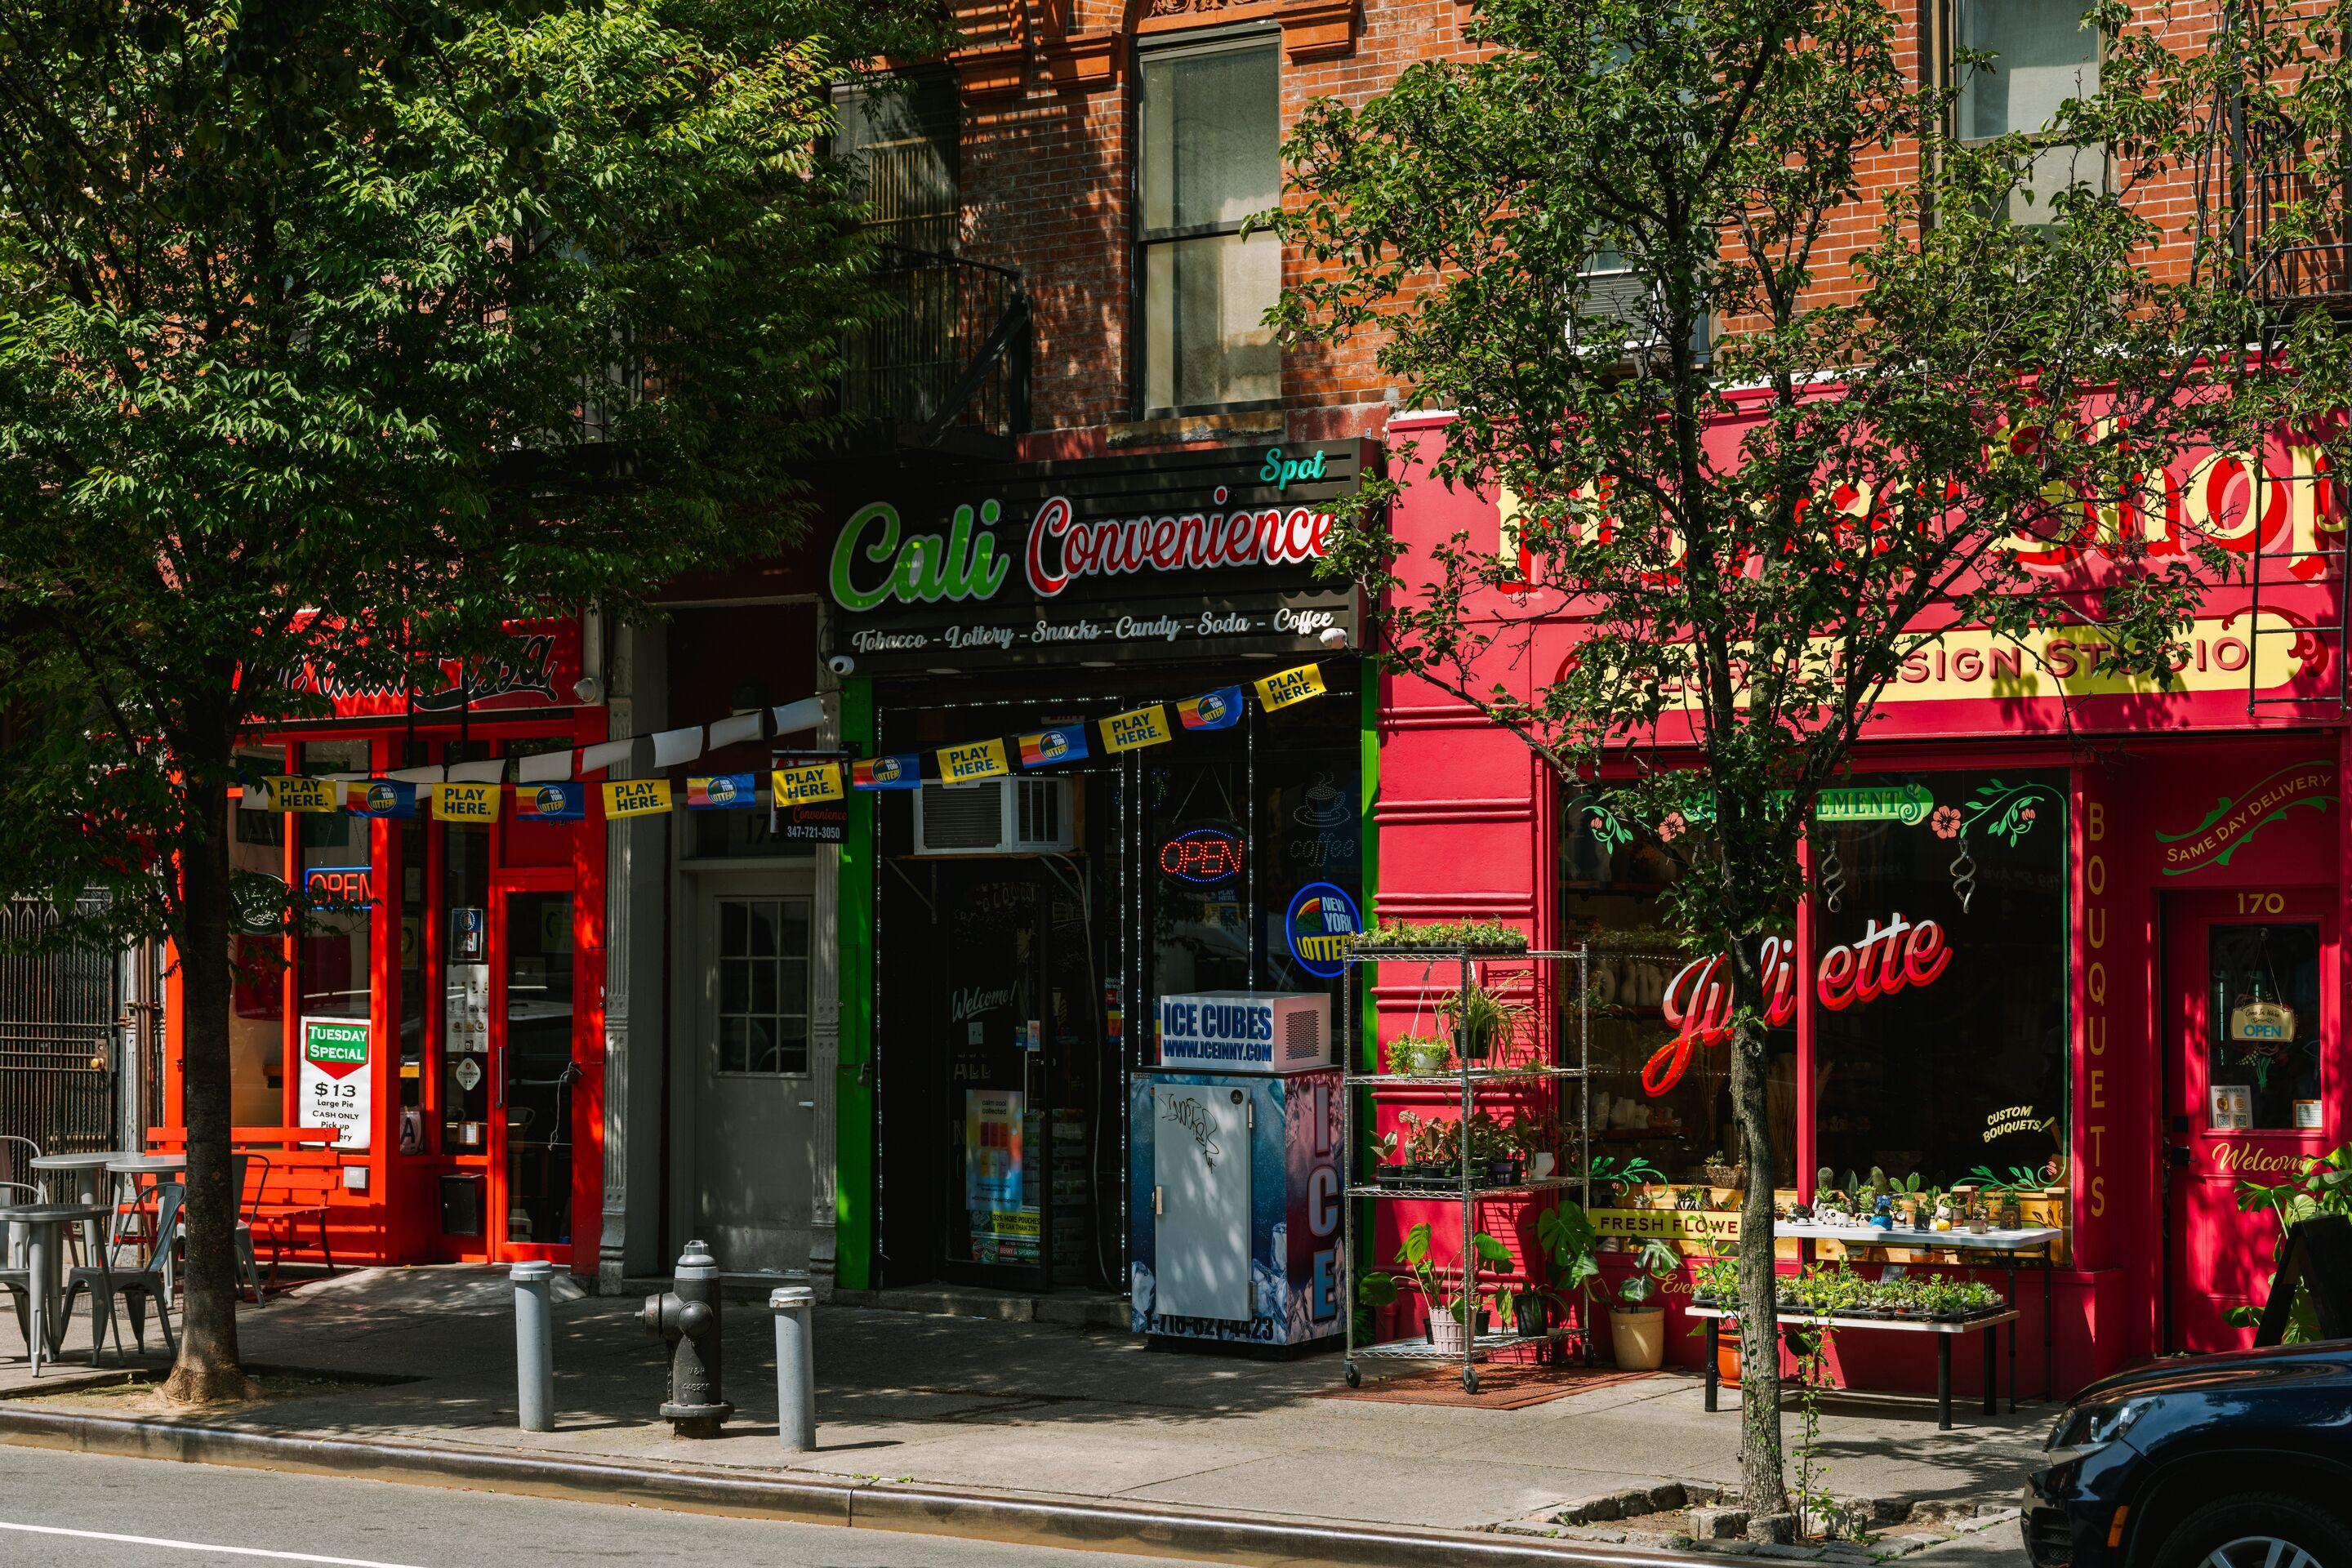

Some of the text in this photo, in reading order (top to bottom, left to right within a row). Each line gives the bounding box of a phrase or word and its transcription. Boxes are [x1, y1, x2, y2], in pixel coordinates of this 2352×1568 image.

[1260, 448, 1327, 490] Spot
[830, 486, 1341, 612] Cali Convenience
[852, 629, 928, 653] Tobacco
[944, 625, 1014, 649] Lottery
[1031, 619, 1101, 644] Snacks
[1116, 616, 1181, 642] Candy
[1197, 612, 1250, 636] Soda
[1273, 608, 1334, 635] Coffee
[1833, 646, 2021, 685] SIGN
[1267, 670, 1304, 693] PLAY
[1272, 681, 1317, 705] HERE.
[1111, 713, 1150, 733] PLAY
[1115, 726, 1162, 746] HERE.
[950, 746, 989, 764] PLAY
[785, 768, 825, 786] PLAY
[952, 759, 1000, 777] HERE.
[280, 781, 320, 793] PLAY
[444, 788, 485, 800] PLAY
[615, 782, 655, 798] PLAY
[787, 782, 835, 800] HERE.
[280, 794, 328, 807] HERE.
[444, 801, 492, 815] HERE.
[617, 795, 664, 811] HERE.
[792, 805, 848, 824] Convenience
[2167, 774, 2332, 862] SAME DAY DELIVERY
[787, 826, 840, 840] 347-721-3050
[1160, 840, 1243, 874] OPEN
[1290, 832, 1356, 869] coffee
[1321, 897, 1346, 913] NEW
[2238, 893, 2285, 914] 170
[1324, 912, 1353, 933] YORK
[1296, 935, 1355, 961] LOTTER
[952, 980, 1017, 1022] Welcome!
[2087, 802, 2106, 1218] BOUQUETS
[1164, 1002, 1272, 1040] ICE CUBES
[308, 1026, 367, 1042] TUESDAY
[2243, 1024, 2282, 1038] OPEN
[310, 1044, 364, 1061] SPECIAL
[1163, 1040, 1272, 1062] WWW.ICEINNY.COM
[314, 1082, 356, 1097] $13
[318, 1099, 354, 1108] Large Pie
[1987, 1106, 2033, 1125] CUSTOM
[1983, 1116, 2055, 1143] BOUQUETS!
[2212, 1143, 2318, 1171] Welcom
[1308, 1083, 1339, 1323] ICE
[1018, 1216, 1040, 1225] POUCHES
[1601, 1217, 1738, 1234] FRESH FLOWE
